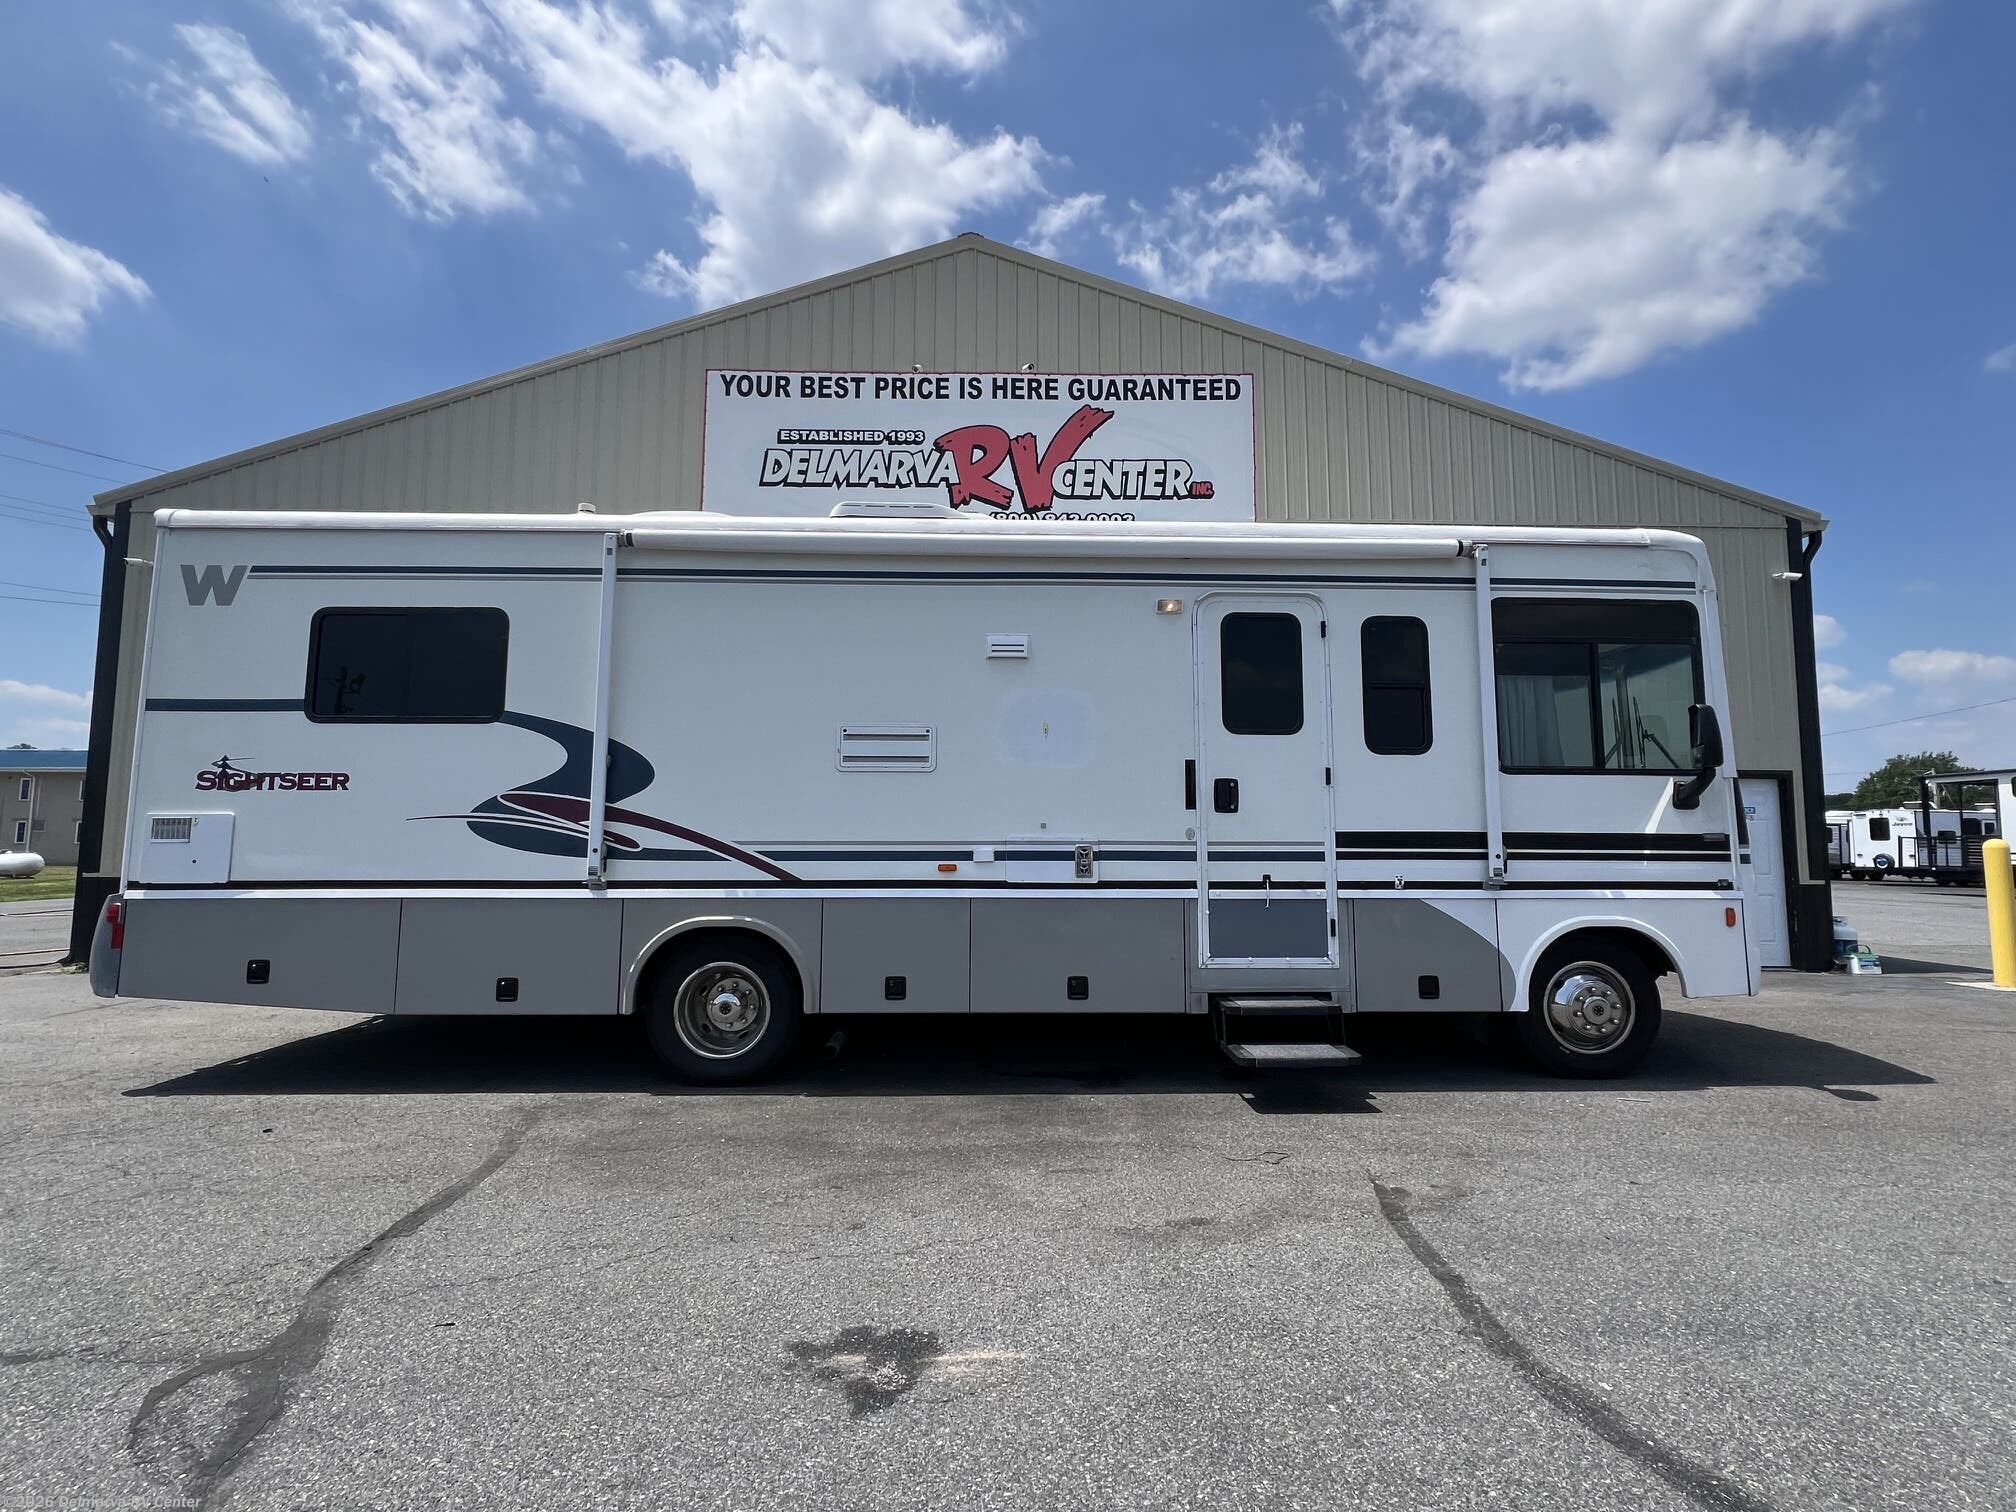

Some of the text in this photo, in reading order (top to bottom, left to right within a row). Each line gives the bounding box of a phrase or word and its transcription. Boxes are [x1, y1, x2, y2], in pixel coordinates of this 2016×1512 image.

[720, 374, 1241, 401] YOUR BEST PRICE IS HERE GUARANTEED
[779, 429, 925, 444] ESTABLISHED 1993
[759, 404, 1214, 511] DELMARVA RV CENTER INC.
[180, 564, 248, 606] W
[195, 769, 350, 792] SIGHTSEER
